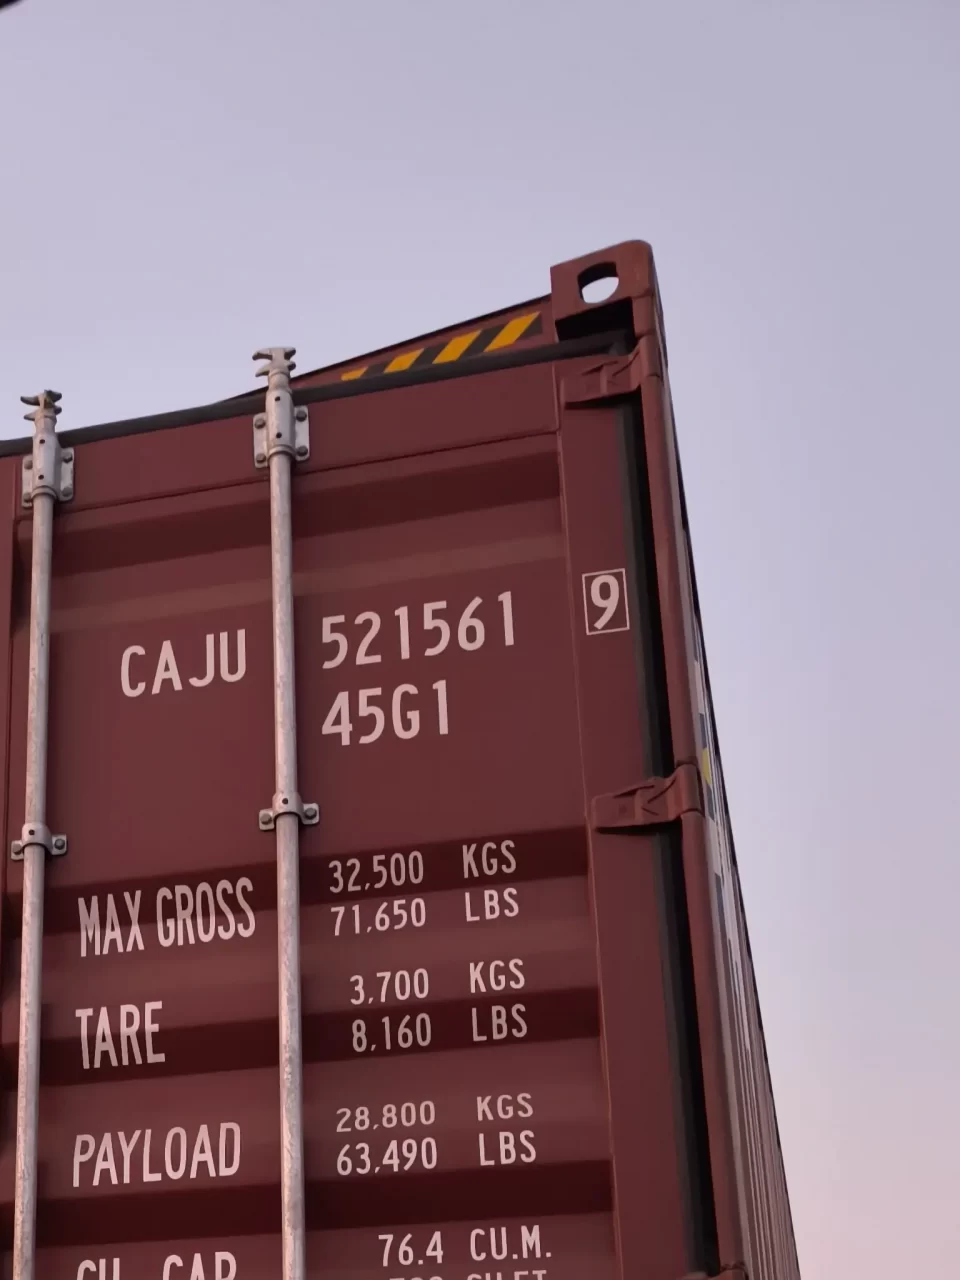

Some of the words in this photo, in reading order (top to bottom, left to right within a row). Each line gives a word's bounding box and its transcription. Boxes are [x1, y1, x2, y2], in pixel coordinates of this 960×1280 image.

[120, 628, 247, 698] CAJU
[321, 590, 515, 670] 521561
[590, 574, 620, 630] 9
[321, 679, 449, 746] 45G1
[328, 850, 424, 894] 32,500
[462, 839, 517, 879] KGS
[77, 889, 145, 958] MAX
[156, 876, 256, 948] GROSS
[330, 897, 427, 937] 71,650
[464, 887, 520, 923] LBS
[349, 967, 429, 1006] 3,700
[469, 958, 526, 994] KGS
[75, 1000, 166, 1070] TARE
[351, 1012, 432, 1053] 8,160
[471, 1003, 528, 1042] LBS
[336, 1100, 436, 1133] 28,800
[476, 1092, 534, 1122] KGS
[72, 1121, 241, 1188] PAYLOAD
[336, 1136, 438, 1176] 63,490
[478, 1129, 537, 1167] LBS
[377, 1230, 444, 1267] 76.4
[469, 1224, 552, 1262] CU.M.
